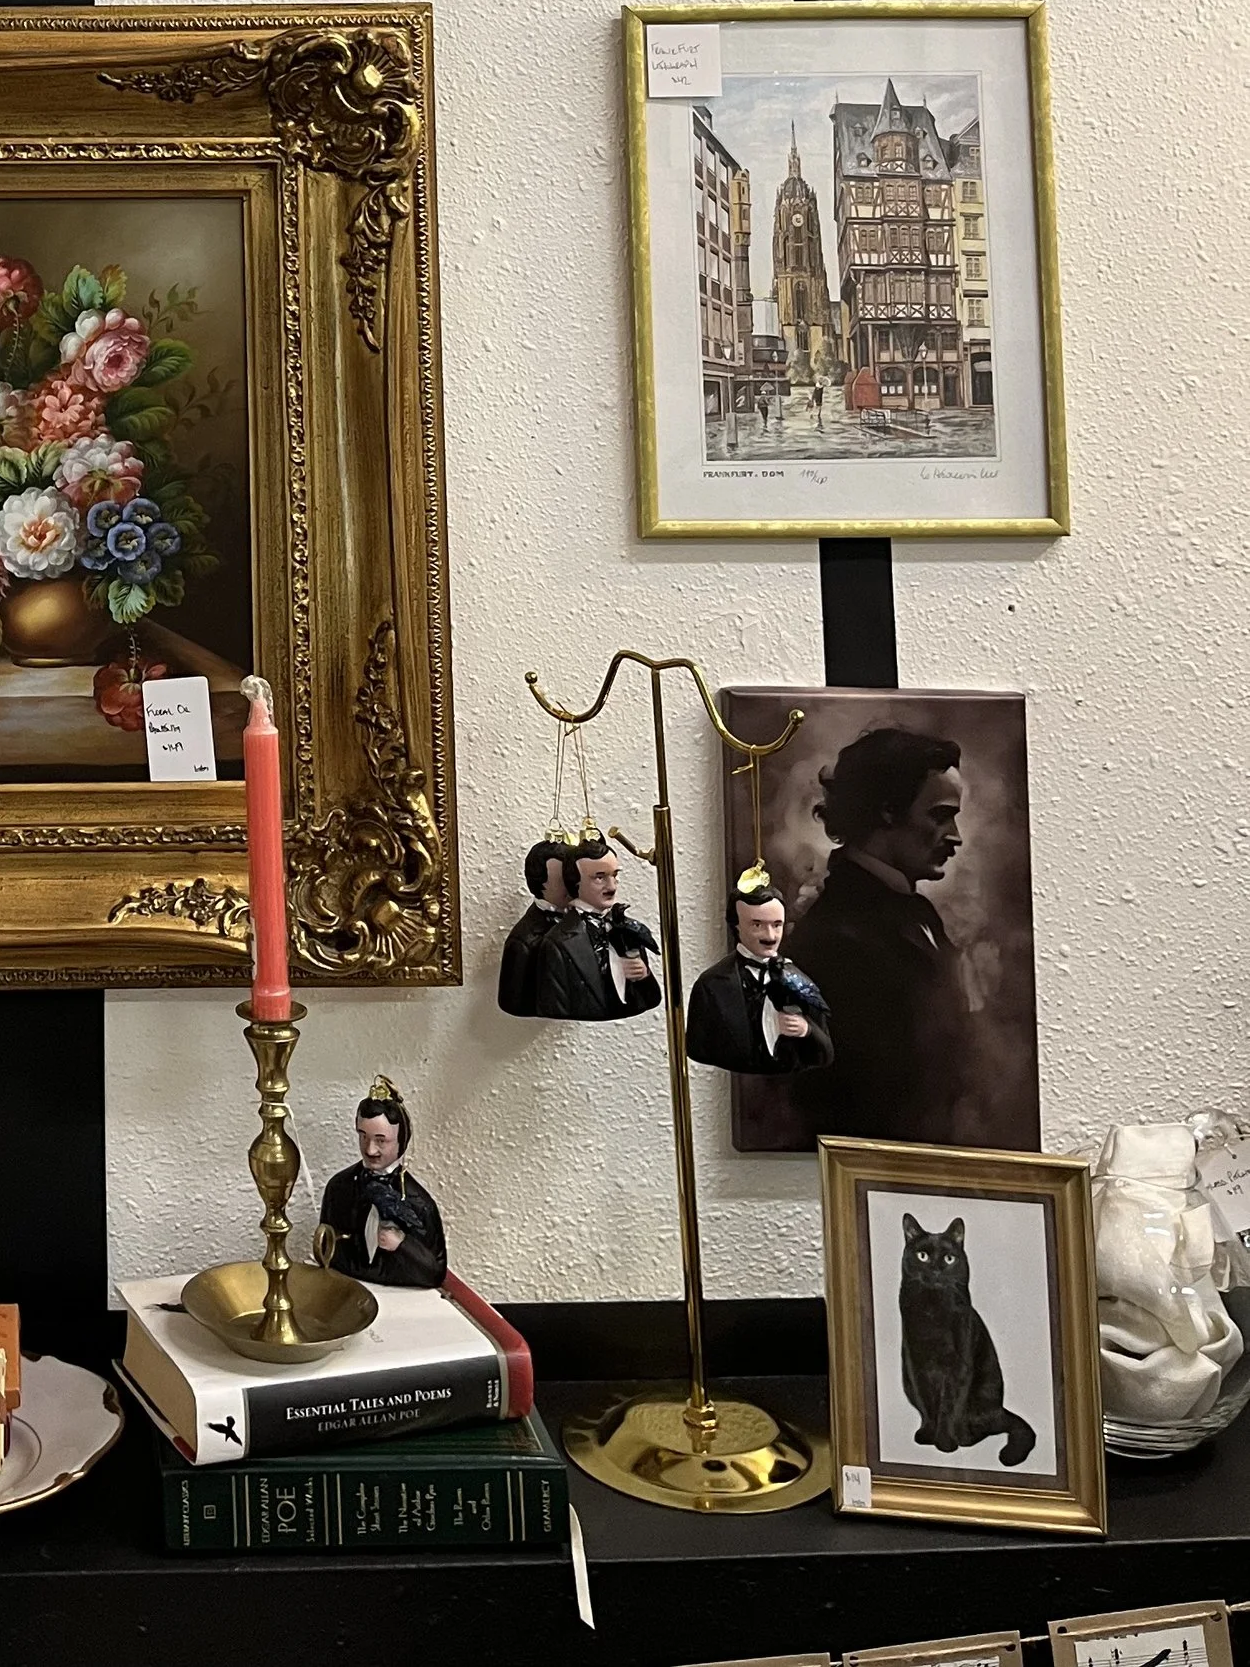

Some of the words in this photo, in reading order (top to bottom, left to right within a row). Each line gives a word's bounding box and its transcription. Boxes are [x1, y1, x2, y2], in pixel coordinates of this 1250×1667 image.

[286, 1400, 348, 1421] ESSENTIAL
[349, 1396, 384, 1412] TALES
[387, 1393, 412, 1406] AND
[414, 1388, 452, 1403] POEMS
[317, 1416, 356, 1432] EDGAR
[359, 1412, 396, 1426] ALLAN
[400, 1408, 421, 1420] POE
[181, 1479, 190, 1514] CLASSICS
[259, 1477, 270, 1510] ALLAN
[276, 1486, 297, 1534] POE
[541, 1479, 551, 1532] GRAMERCY
[261, 1511, 271, 1543] EDGAR
[305, 1508, 316, 1542] Selected
